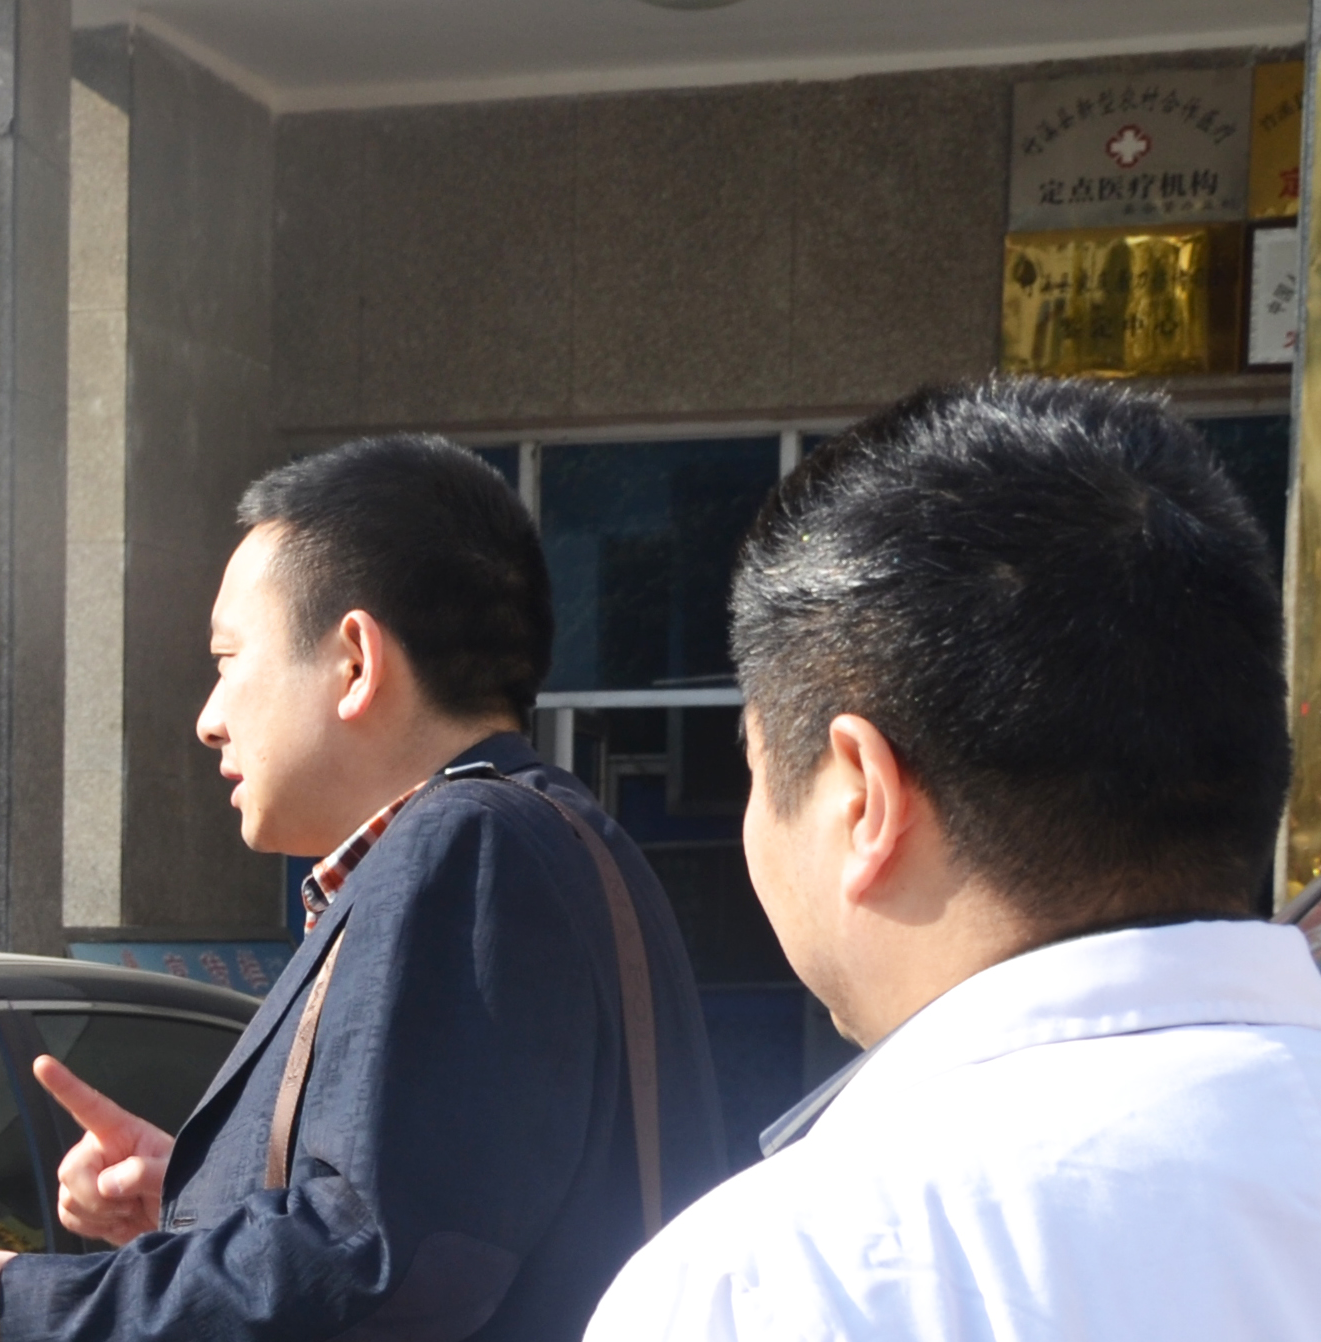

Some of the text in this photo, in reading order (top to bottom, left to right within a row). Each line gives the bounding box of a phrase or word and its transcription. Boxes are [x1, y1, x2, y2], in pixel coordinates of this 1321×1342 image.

[1039, 168, 1219, 206] 定点医疗机构
